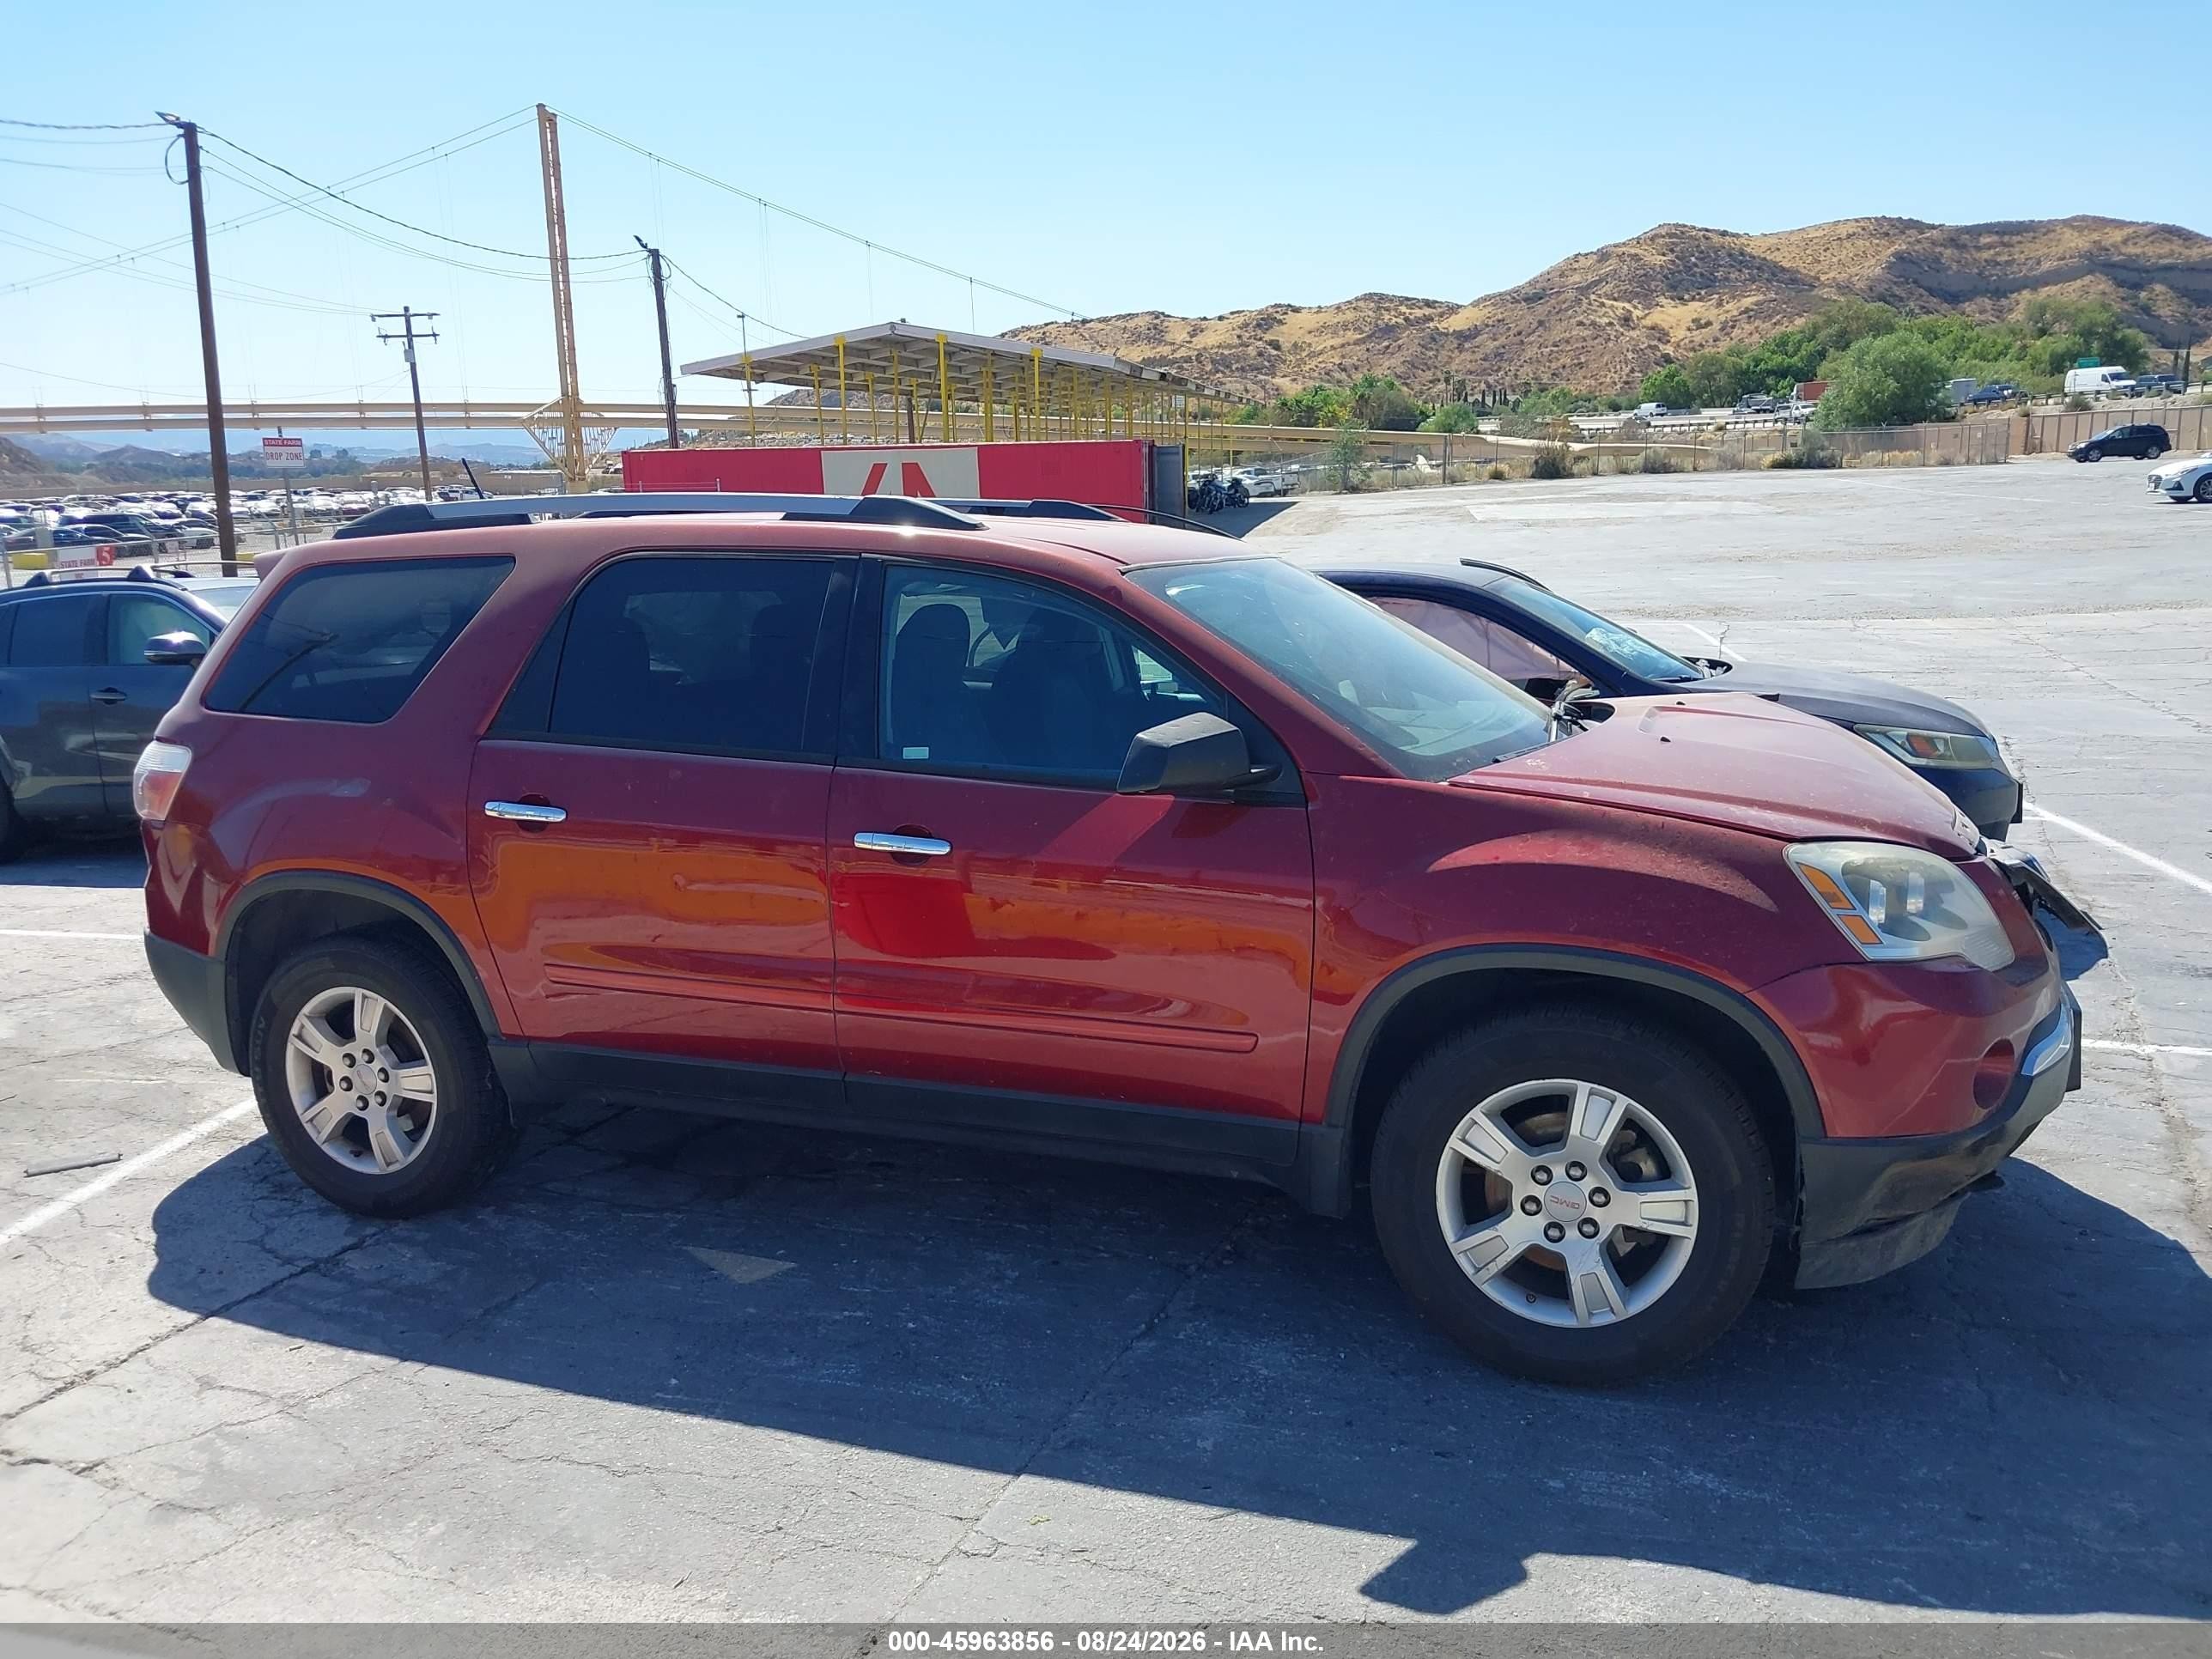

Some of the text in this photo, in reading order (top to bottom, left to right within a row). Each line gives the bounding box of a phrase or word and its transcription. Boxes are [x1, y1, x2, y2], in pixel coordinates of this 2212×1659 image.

[266, 452, 303, 461] DROP ZONE
[102, 546, 111, 565] 5
[1549, 1194, 1580, 1210] GMC
